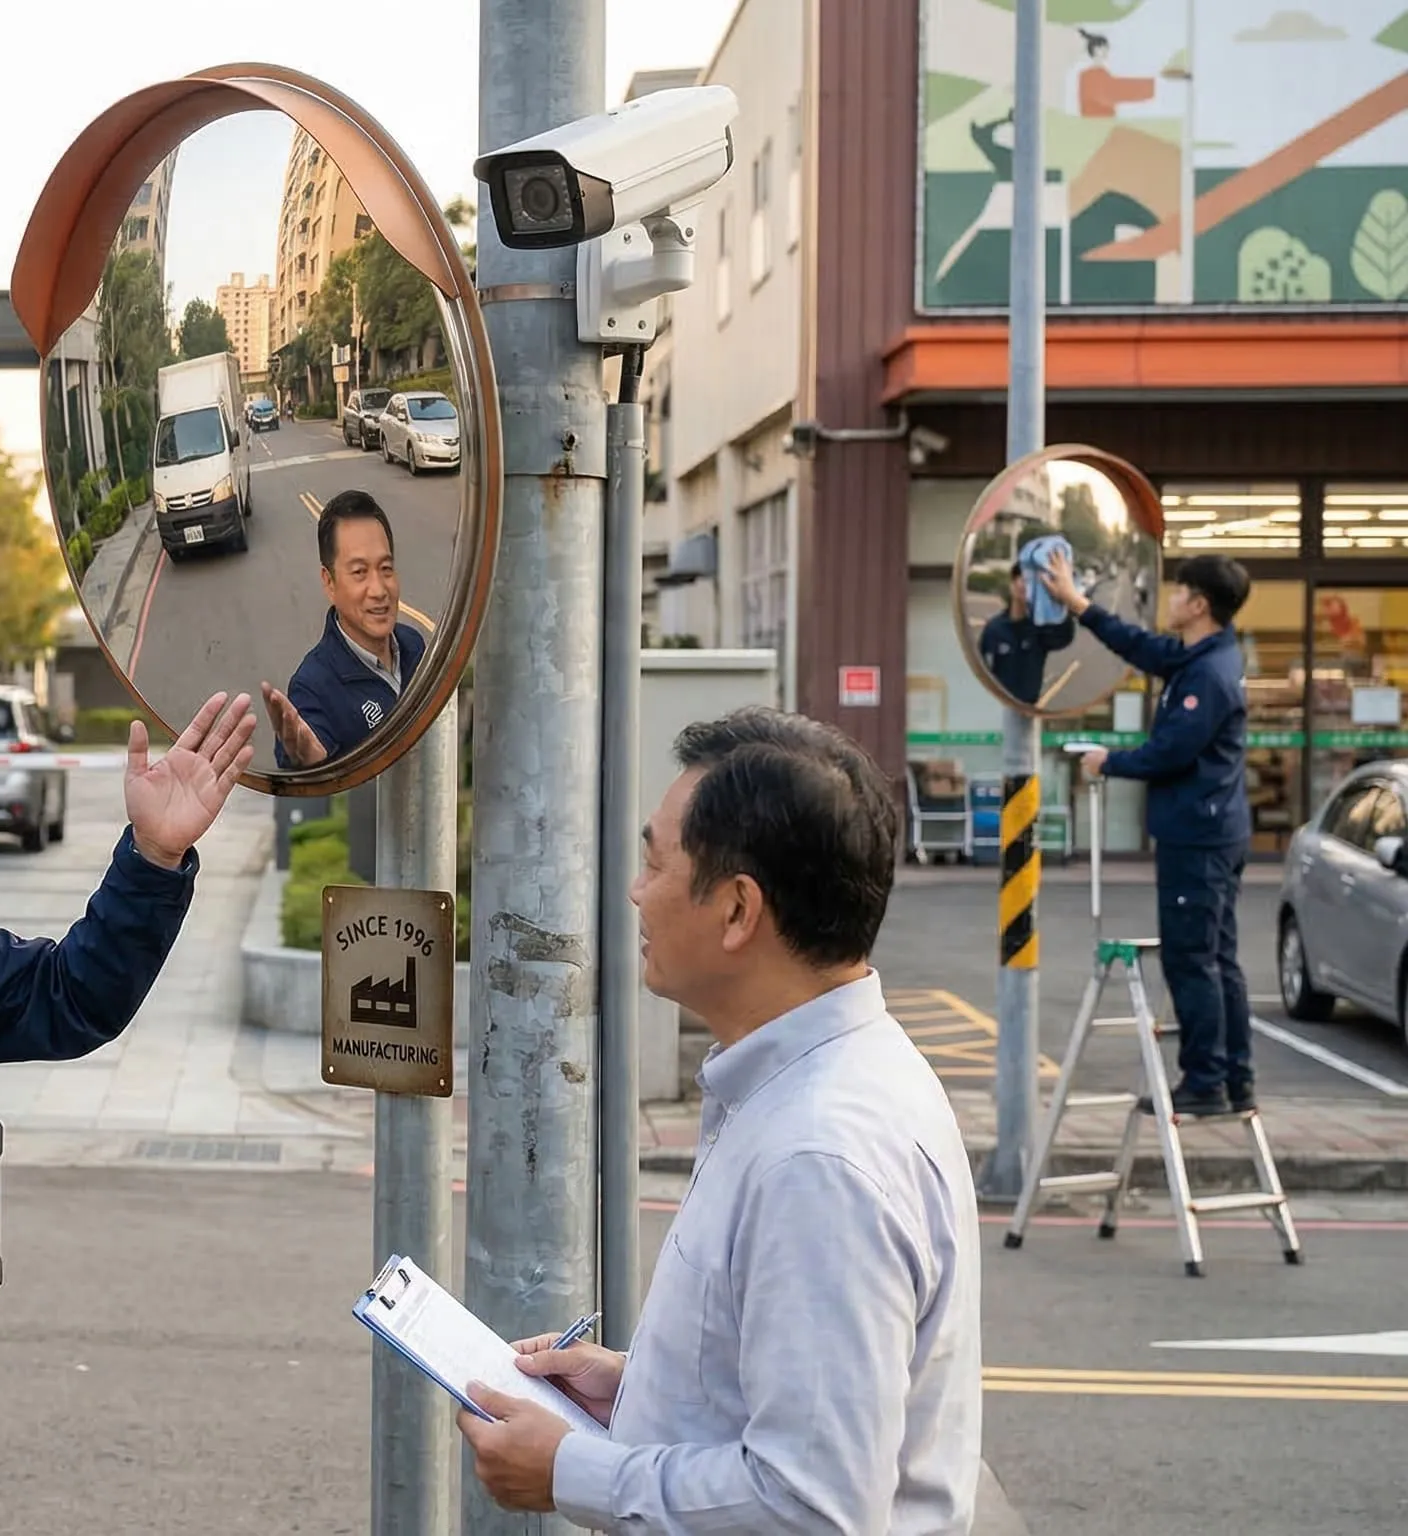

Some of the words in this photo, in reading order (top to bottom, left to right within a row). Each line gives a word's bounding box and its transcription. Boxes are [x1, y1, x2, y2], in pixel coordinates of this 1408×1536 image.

[336, 916, 387, 951] SINCE
[394, 919, 435, 957] 1996
[333, 1038, 438, 1065] MANUFACTURING
